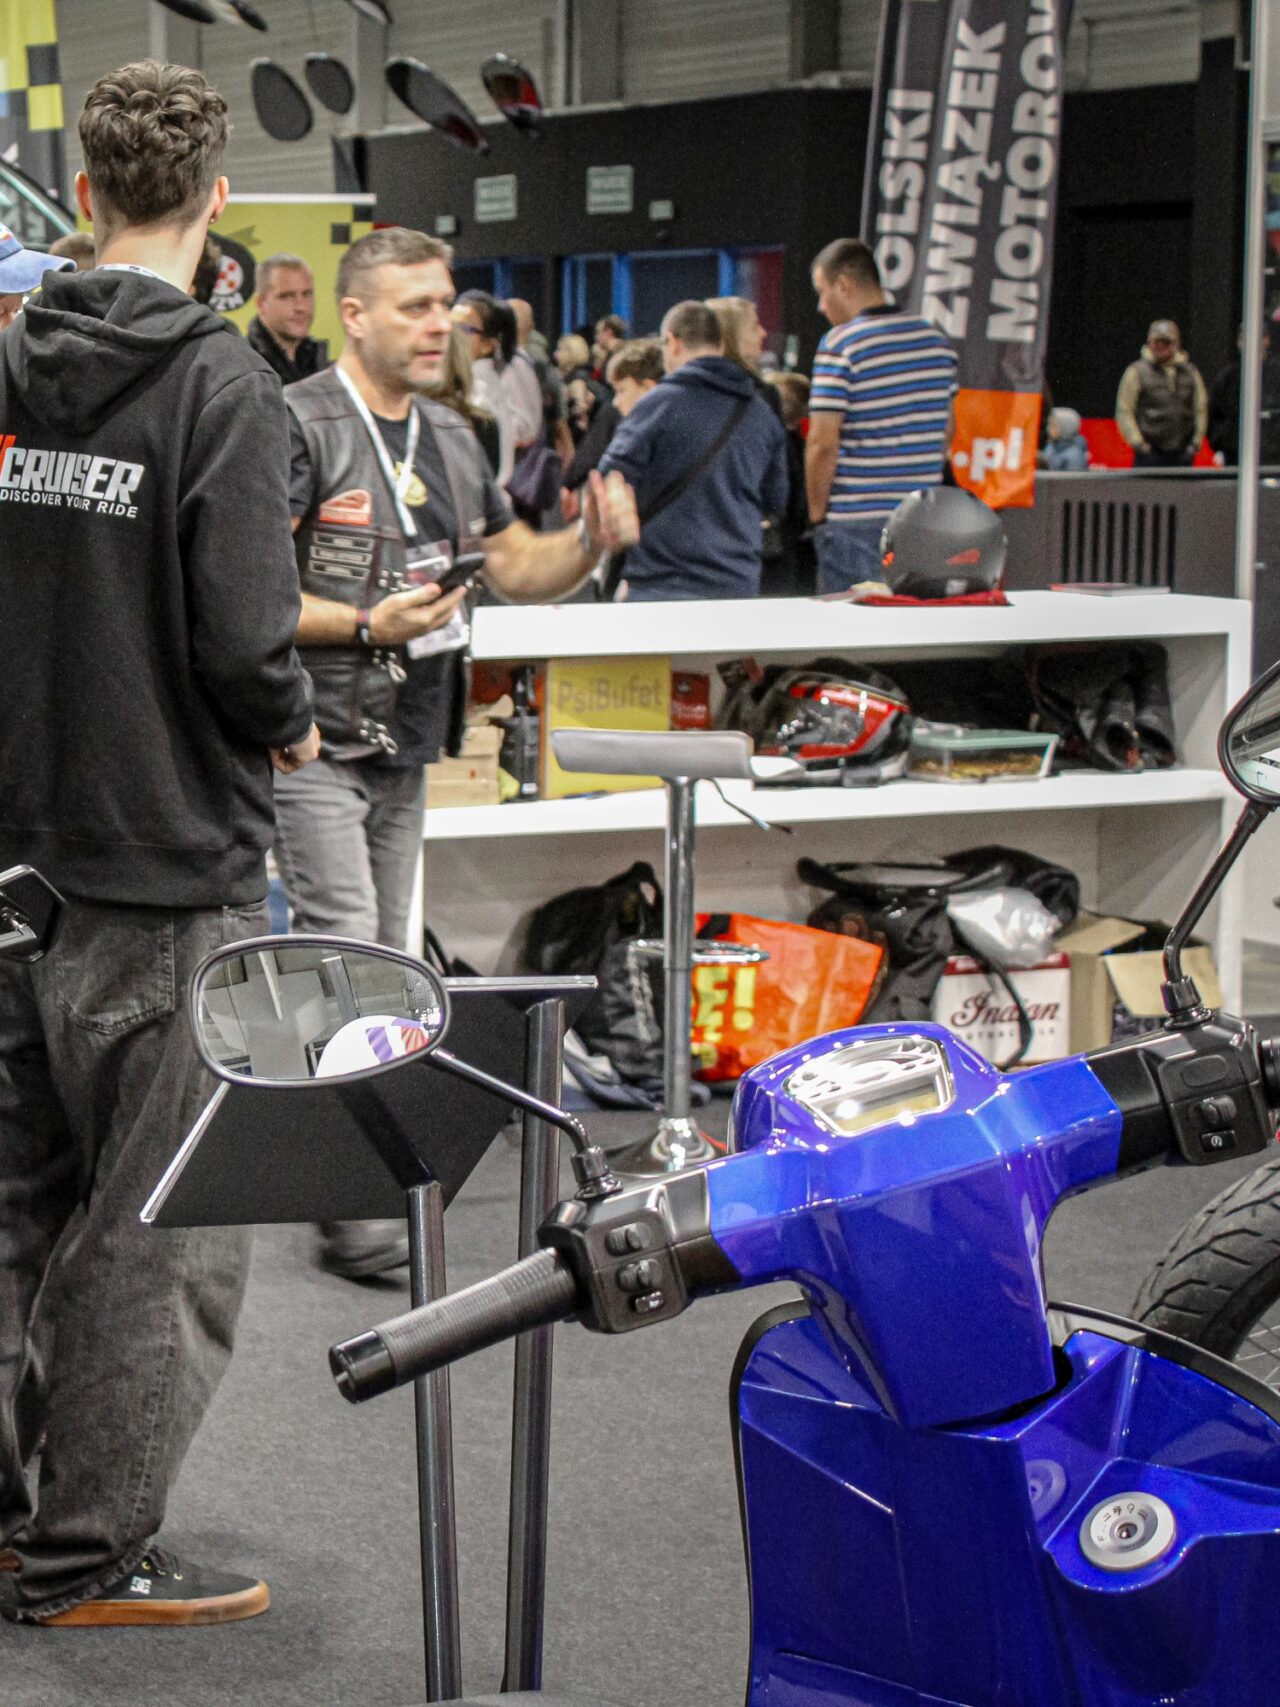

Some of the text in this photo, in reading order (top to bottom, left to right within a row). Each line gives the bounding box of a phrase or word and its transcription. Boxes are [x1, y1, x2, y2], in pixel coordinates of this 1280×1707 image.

[873, 89, 934, 305] OLSKI
[921, 18, 1006, 339] ZWIĄZEK
[954, 427, 1024, 482] .pl
[0, 488, 62, 506] DISCOVER
[96, 501, 139, 519] RIDE
[558, 676, 664, 713] PsiBufet
[951, 990, 1061, 1027] Indan
